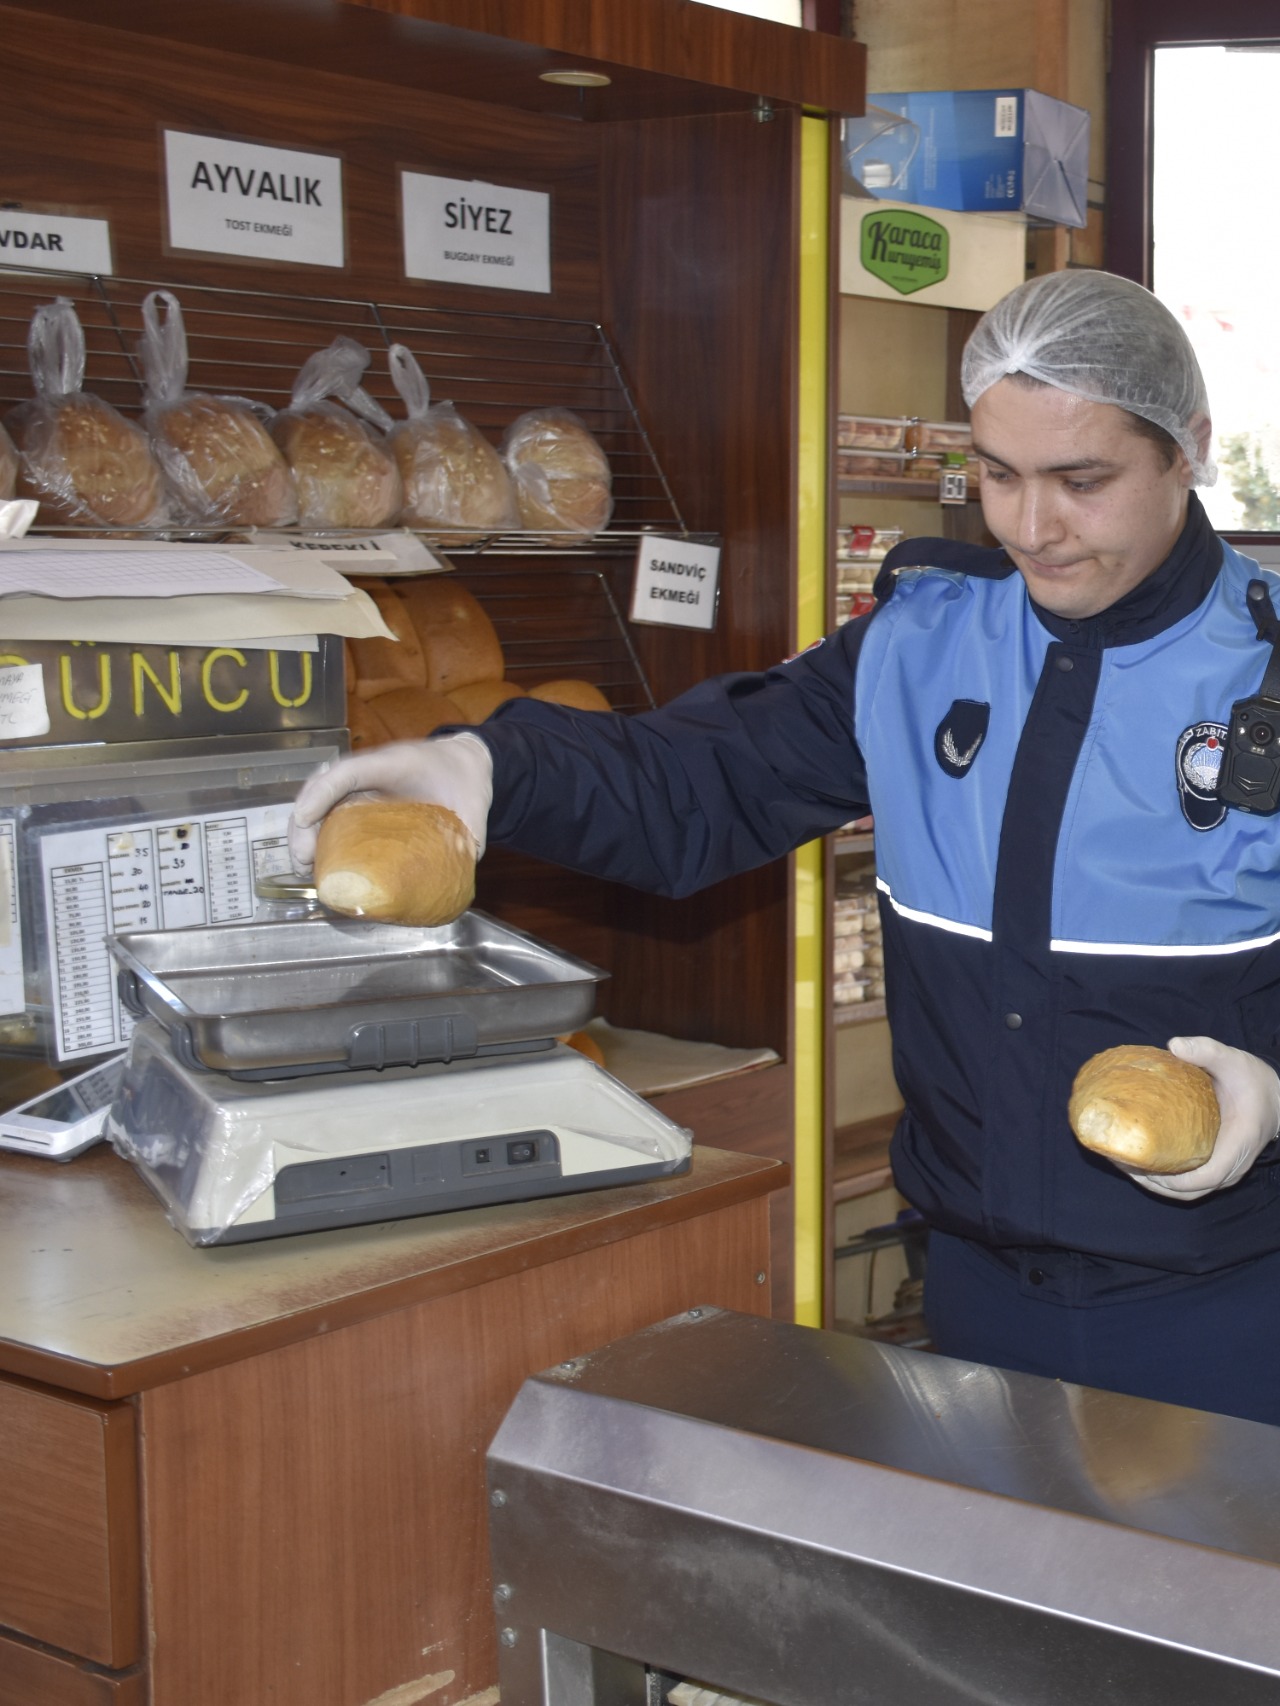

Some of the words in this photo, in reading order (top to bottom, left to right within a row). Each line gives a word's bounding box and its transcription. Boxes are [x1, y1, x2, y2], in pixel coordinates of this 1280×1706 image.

[191, 161, 322, 207] AYVALIK
[444, 197, 513, 235] SİYEZ
[225, 218, 251, 232] TOST
[254, 222, 293, 237] EKMEĞİ
[868, 221, 942, 262] Karaca
[650, 559, 706, 582] SANDVİÇ
[650, 586, 700, 605] EKMEĞİ
[1195, 727, 1228, 740] ZABIT
[131, 867, 143, 876] 30
